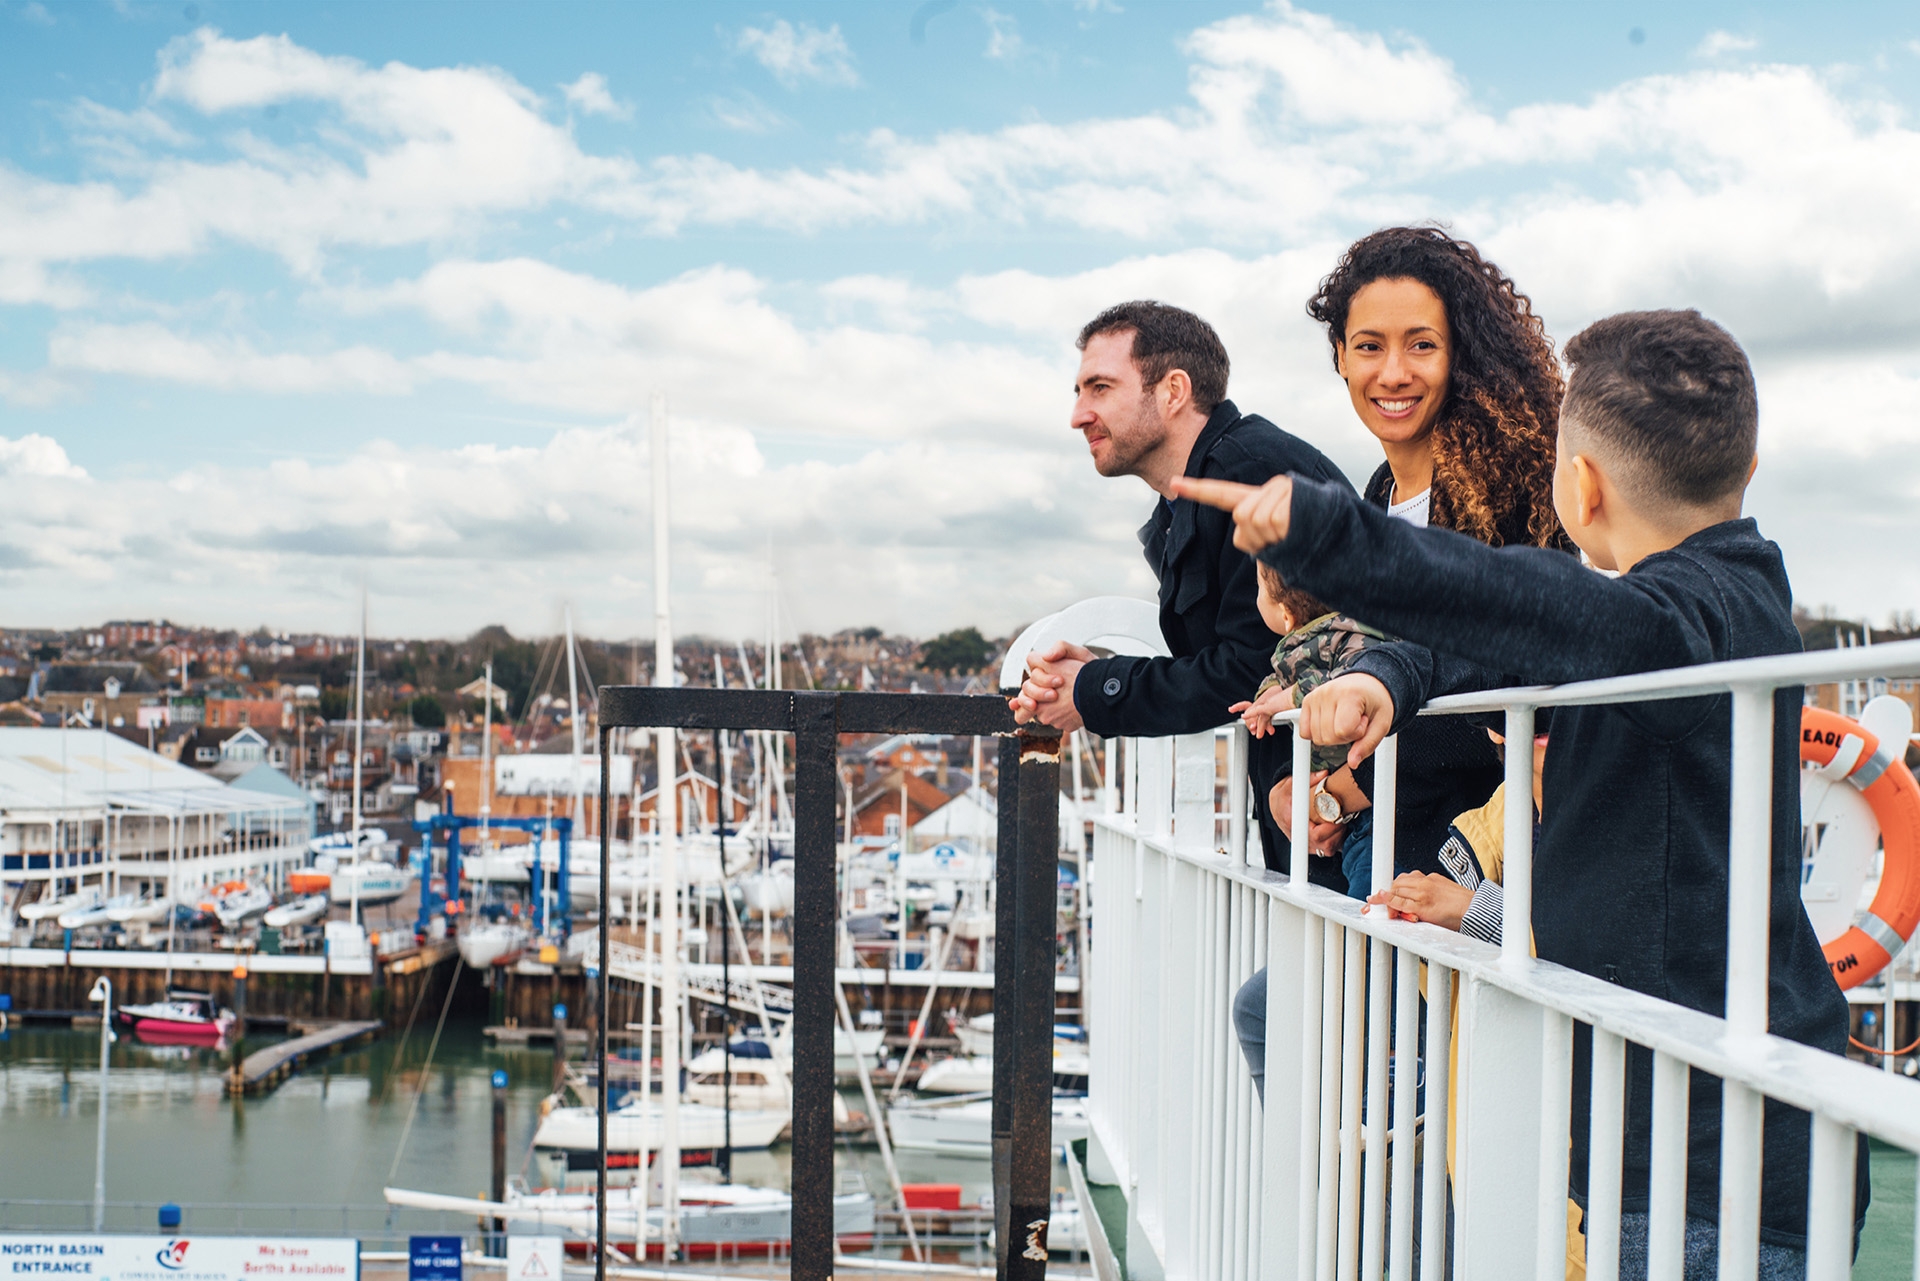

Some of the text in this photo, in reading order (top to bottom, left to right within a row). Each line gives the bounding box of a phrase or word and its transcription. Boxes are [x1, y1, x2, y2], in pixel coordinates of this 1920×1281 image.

[2, 1244, 104, 1255] NORTH BASIN
[13, 1261, 92, 1273] ENTRANCE
[290, 1262, 346, 1274] Available
